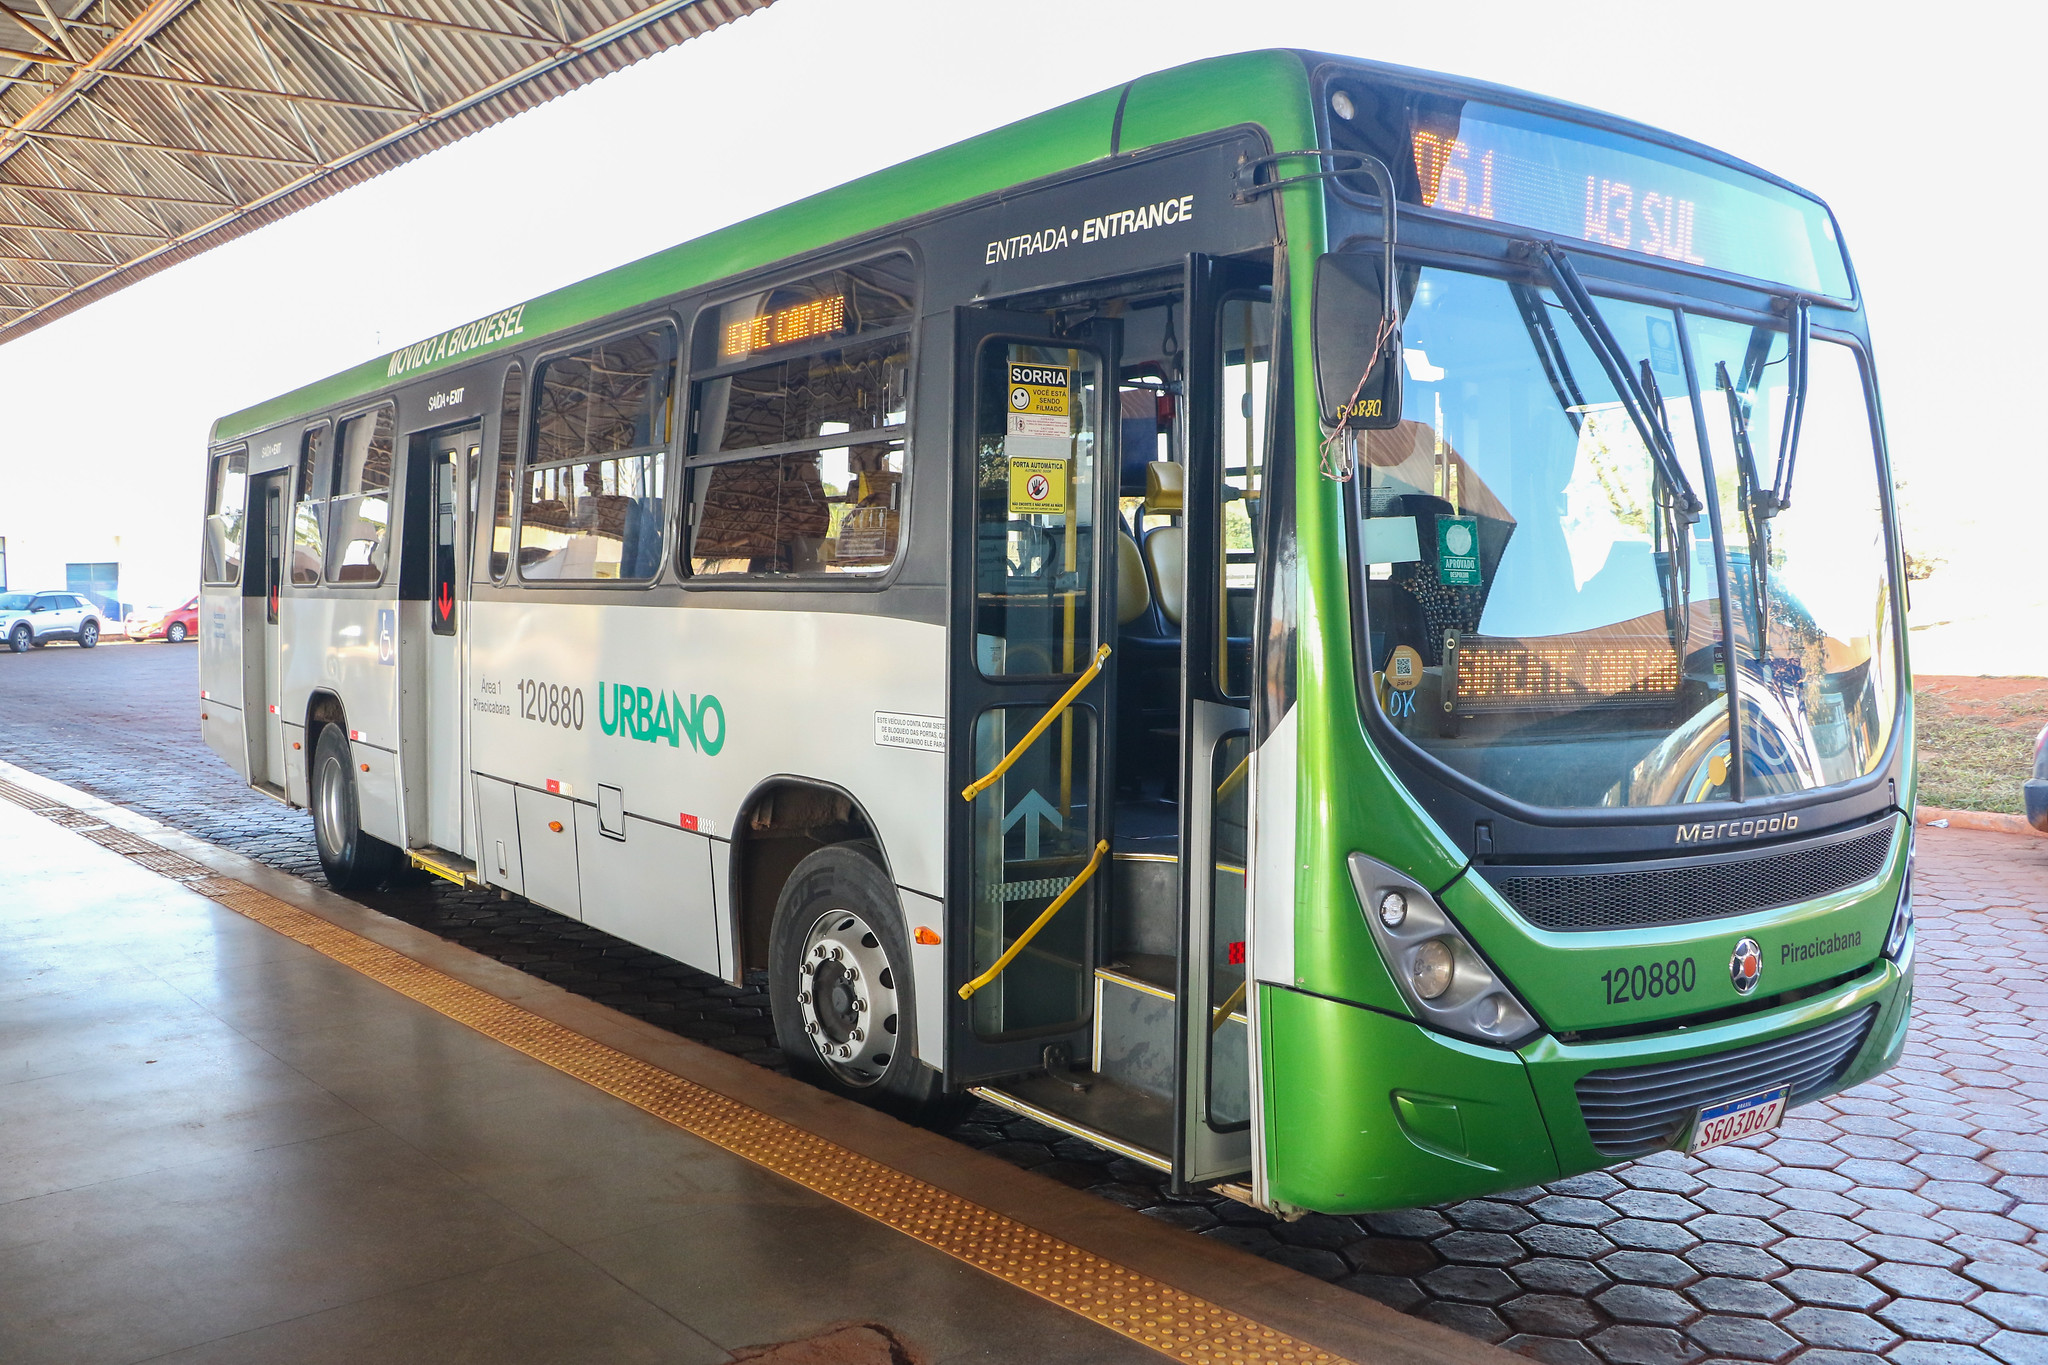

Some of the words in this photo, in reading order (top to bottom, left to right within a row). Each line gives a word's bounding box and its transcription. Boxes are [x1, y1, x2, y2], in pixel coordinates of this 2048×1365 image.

[985, 225, 1068, 265] ENTRADA
[1082, 194, 1194, 244] ENTRANCE
[1584, 175, 1633, 249] W3
[1641, 191, 1704, 266] SUL
[387, 336, 438, 378] MOVIDO
[435, 332, 448, 362] A
[447, 304, 526, 357] BIODIESEL
[1012, 368, 1066, 385] SORRIA
[428, 392, 446, 412] SAÍDA
[449, 387, 465, 406] EXIT
[1051, 390, 1067, 398] ESTÁ
[1030, 461, 1063, 470] AUTOMÁTICA
[1445, 559, 1475, 569] APROVADO
[481, 674, 497, 695] Área
[497, 680, 502, 695] 1
[1457, 649, 1576, 696] SOMENTE
[473, 698, 511, 716] Piracicabana
[517, 678, 584, 731] 120880
[1391, 689, 1416, 718] OK
[598, 680, 726, 757] URBANO
[877, 716, 888, 724] ESTE
[888, 716, 906, 726] VEÍCULO
[907, 720, 921, 728] CONTA
[888, 726, 909, 736] BLOQUEIO
[910, 728, 919, 736] DAS
[882, 734, 889, 742] SÓ
[890, 735, 904, 743] ABREM
[905, 737, 923, 746] QUANDO
[924, 739, 933, 747] ELE
[1674, 812, 1799, 844] Marcopolo
[1781, 930, 1862, 965] Piracicabana
[1600, 957, 1697, 1005] 120880
[1736, 1101, 1752, 1110] BRASIL
